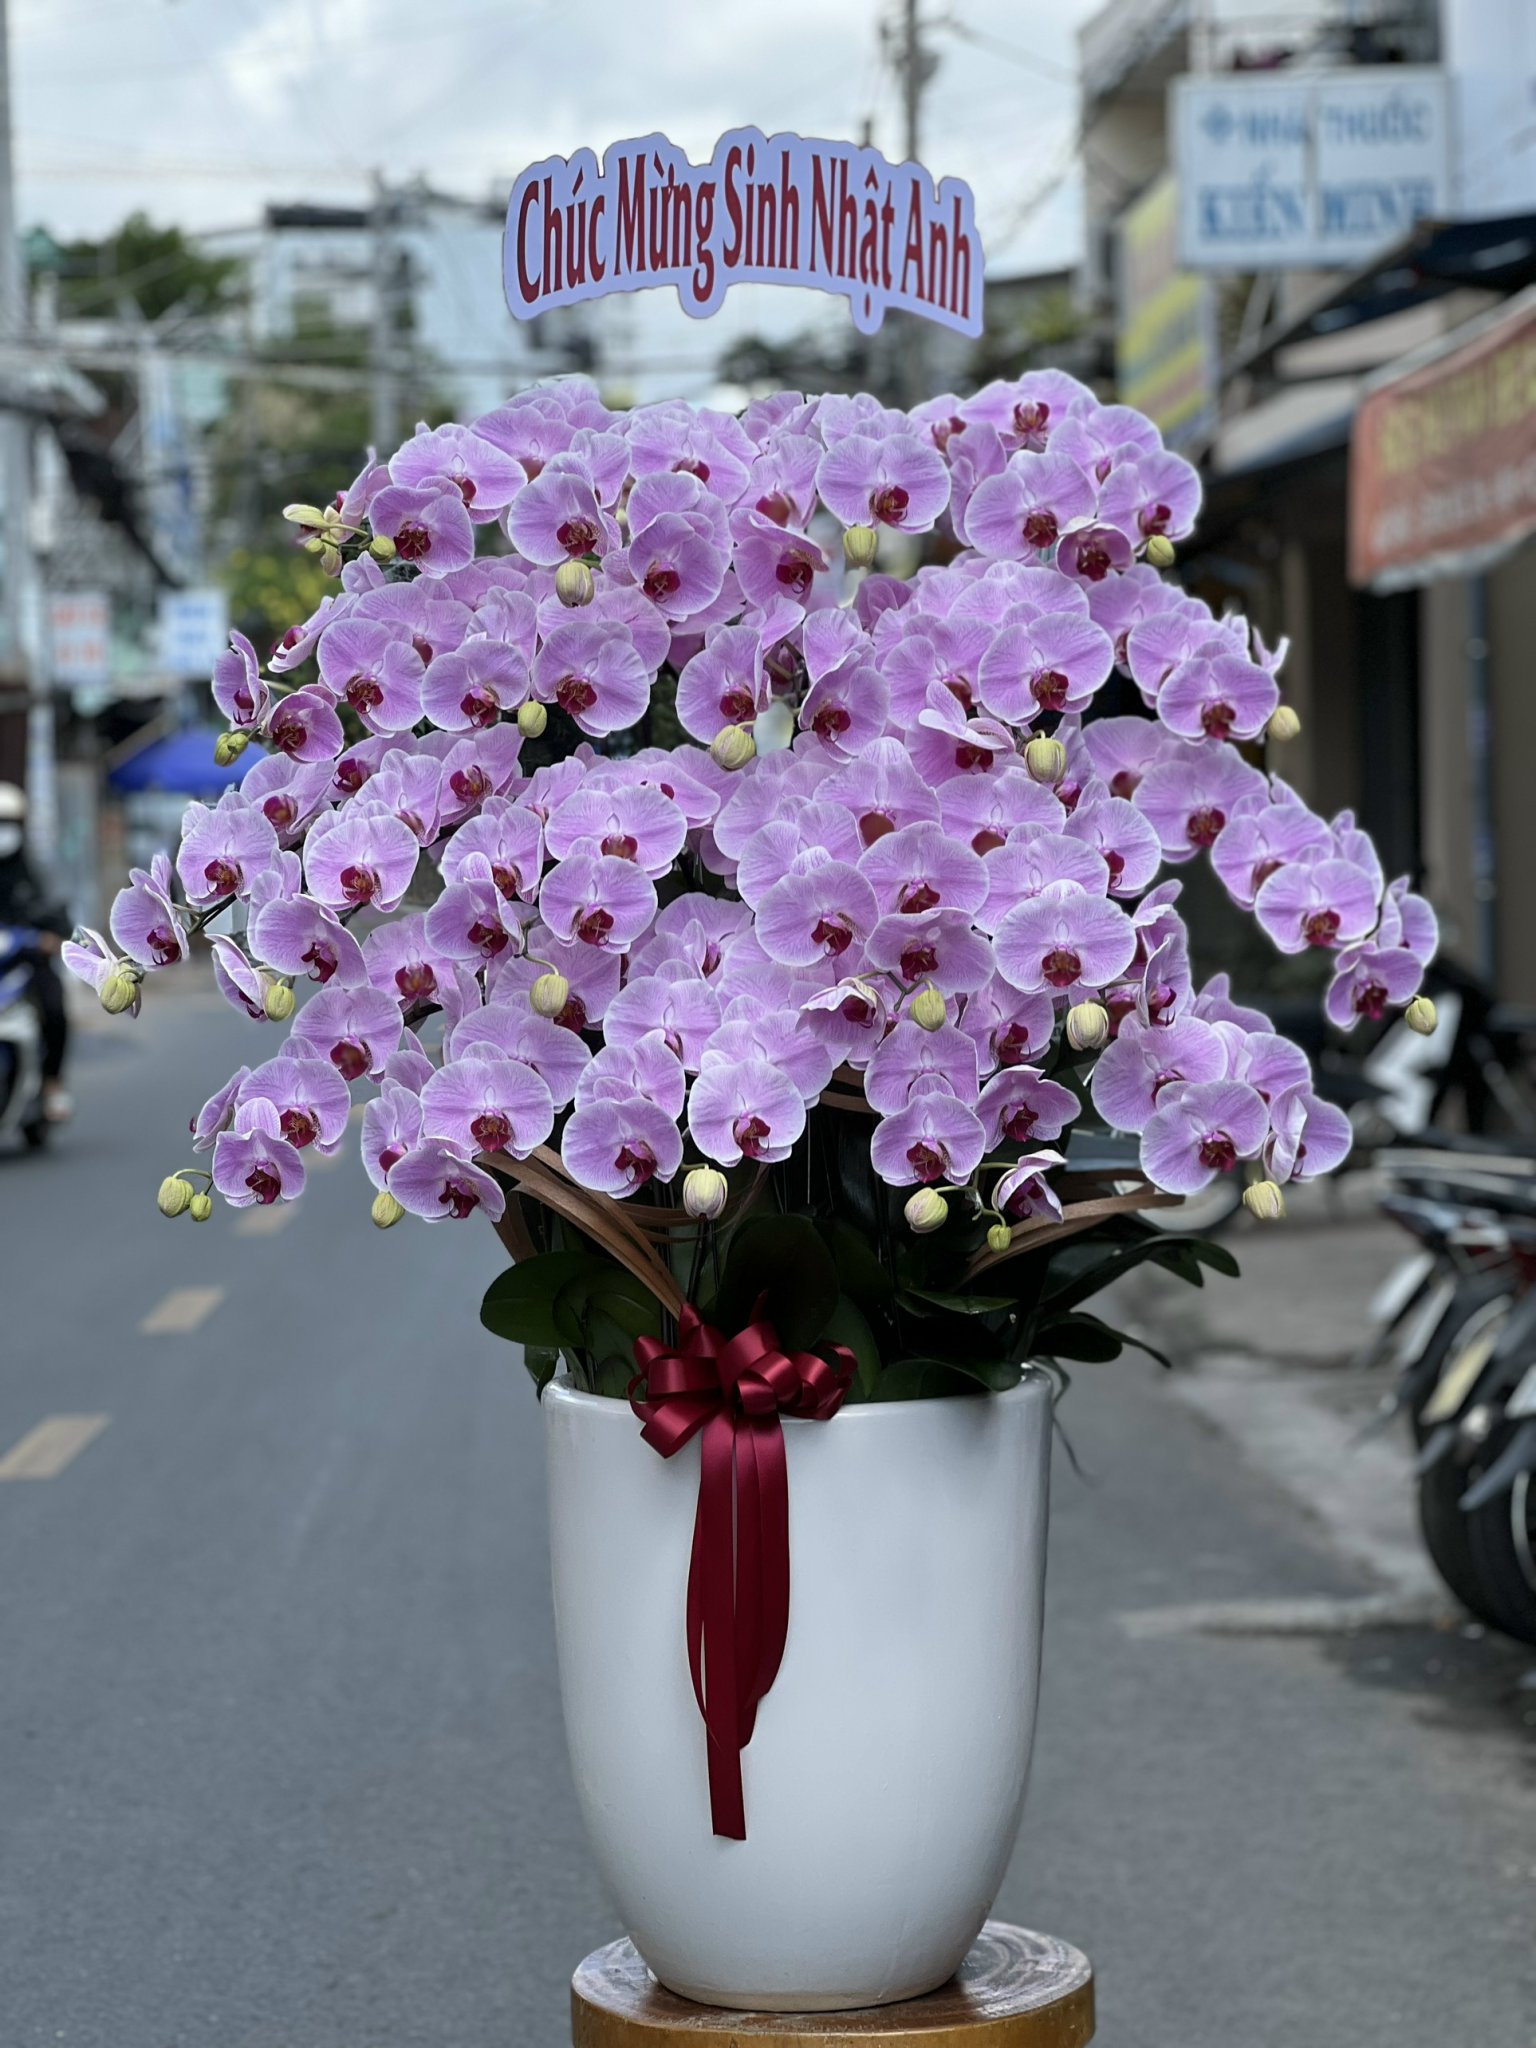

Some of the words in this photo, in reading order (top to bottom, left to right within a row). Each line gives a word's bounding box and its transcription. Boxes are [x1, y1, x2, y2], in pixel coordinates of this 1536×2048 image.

[516, 166, 605, 303] Chúc
[614, 149, 717, 302] Mừng
[722, 143, 799, 270] Sinh
[809, 154, 895, 318] Nhật
[901, 178, 970, 320] Anh
